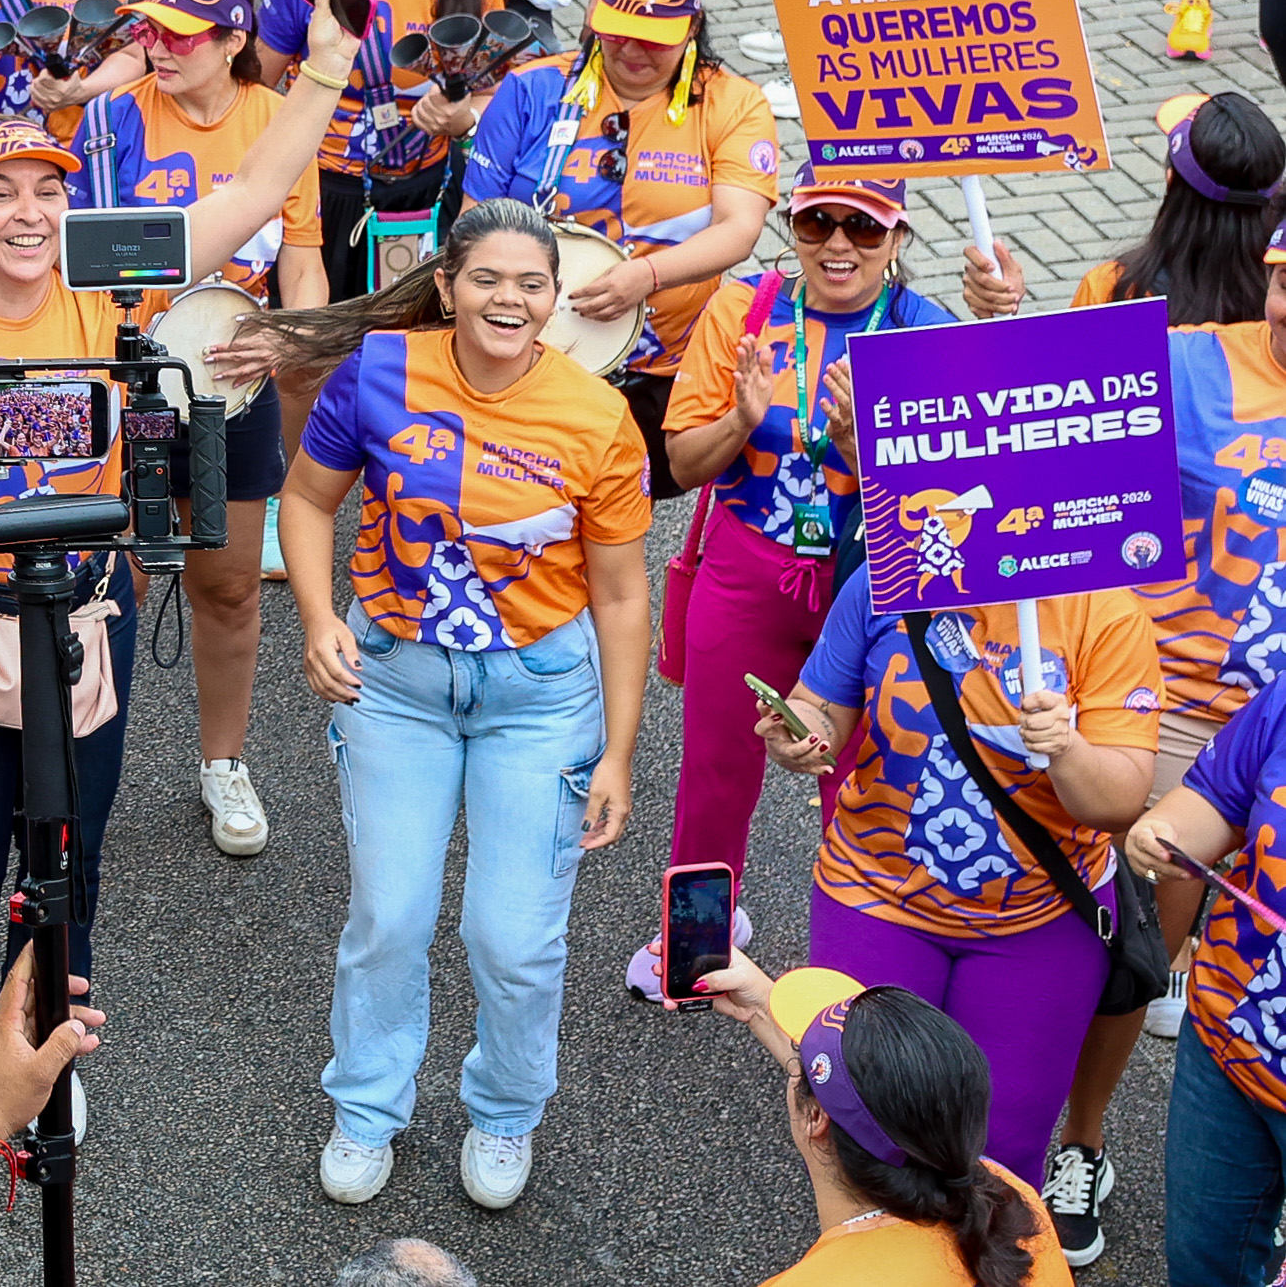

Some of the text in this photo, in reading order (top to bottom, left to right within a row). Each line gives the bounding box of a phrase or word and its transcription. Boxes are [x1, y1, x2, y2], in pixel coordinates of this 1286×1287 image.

[821, 1, 1037, 49] QUEREMOS
[817, 39, 1060, 83] AS MULHERES
[812, 77, 1079, 131] VIVAS
[976, 131, 1042, 144] MARCHA 2026
[977, 143, 1025, 154] MULHER
[838, 144, 877, 157] ALECE
[635, 170, 708, 188] MULHER
[112, 243, 141, 253] Ulanzi
[874, 371, 1158, 428] É PELA VIDA DAS
[875, 406, 1163, 467] MULHERES
[482, 441, 562, 471] MARCHA
[482, 453, 500, 463] em
[476, 462, 565, 491] MULHER
[1053, 491, 1152, 512] MARCHA 2026
[1246, 488, 1284, 512] VIVAS
[1053, 511, 1123, 530] MULHER
[1019, 554, 1070, 572] ALECE
[935, 620, 963, 657] VIVAS
